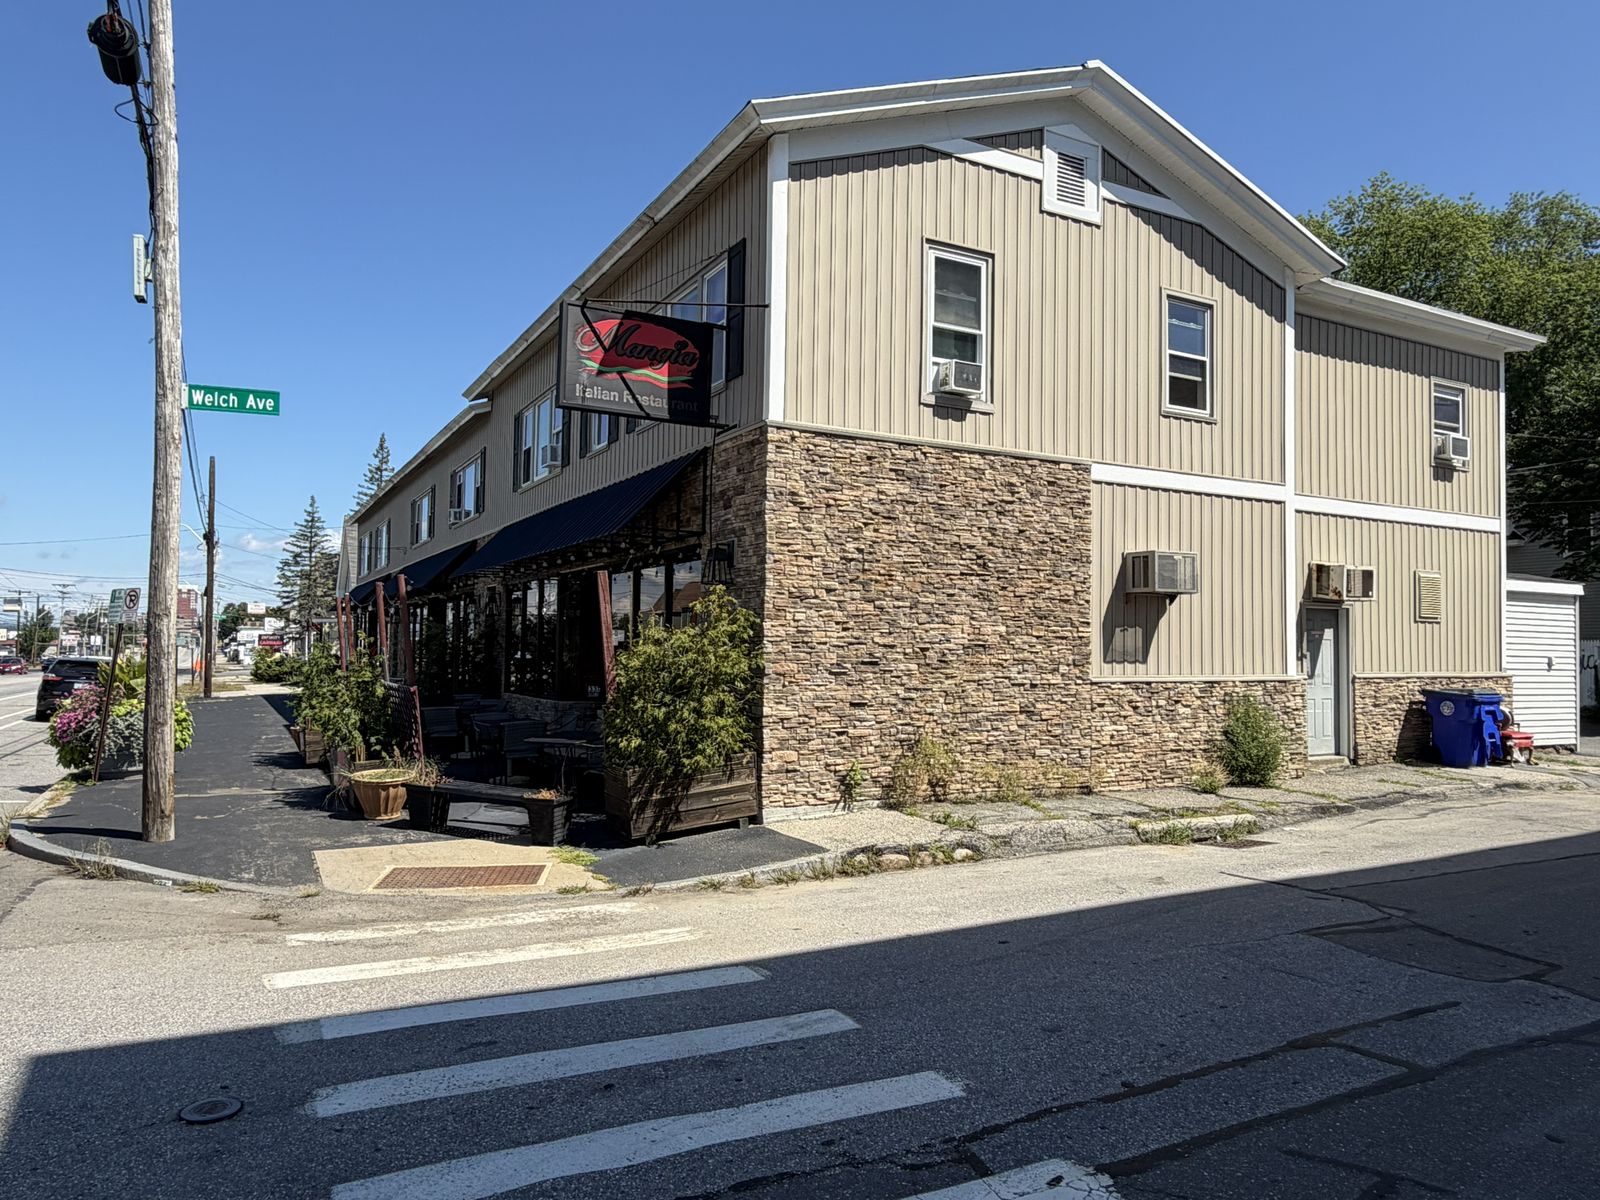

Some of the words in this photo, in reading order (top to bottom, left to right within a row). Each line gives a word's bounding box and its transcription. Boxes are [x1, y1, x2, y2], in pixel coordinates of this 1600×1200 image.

[575, 322, 699, 370] Mangia
[191, 389, 238, 408] Welch
[245, 393, 275, 411] Ave
[575, 383, 619, 402] Italian
